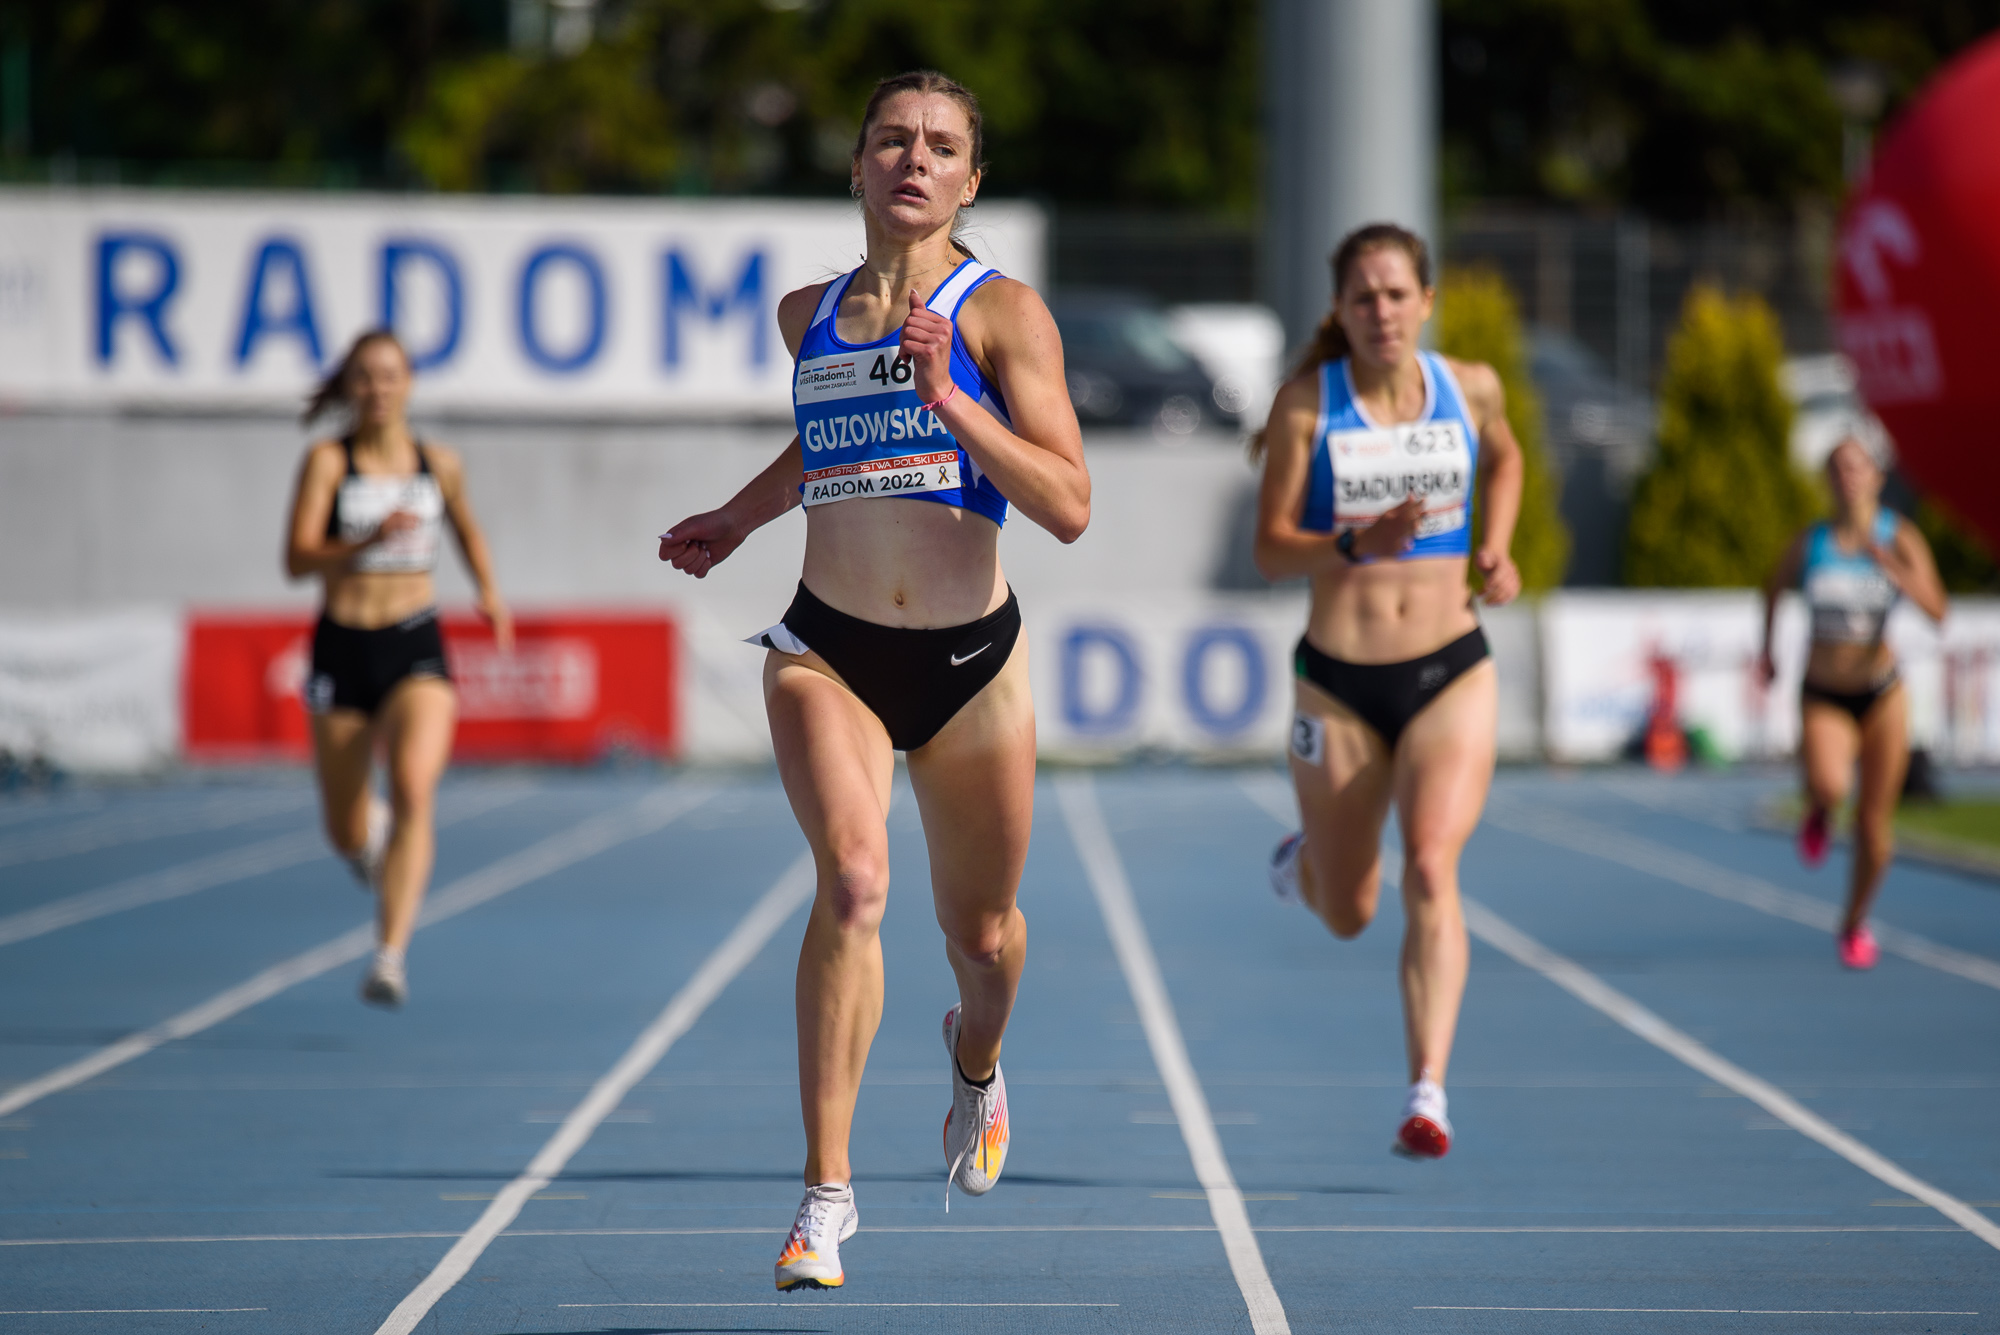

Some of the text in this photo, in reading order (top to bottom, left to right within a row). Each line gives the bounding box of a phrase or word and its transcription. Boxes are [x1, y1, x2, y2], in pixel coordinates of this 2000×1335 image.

[93, 230, 772, 374] RADOM
[800, 368, 857, 385] visitRadom.pl
[814, 383, 831, 391] RADOM
[805, 407, 947, 452] GUZOWSKA
[1404, 429, 1457, 455] 623
[807, 453, 955, 481] PZLA MISTRZOSTWA POLSKI U20
[812, 472, 926, 500] RADOM 2022
[1341, 470, 1460, 502] SADURSKA
